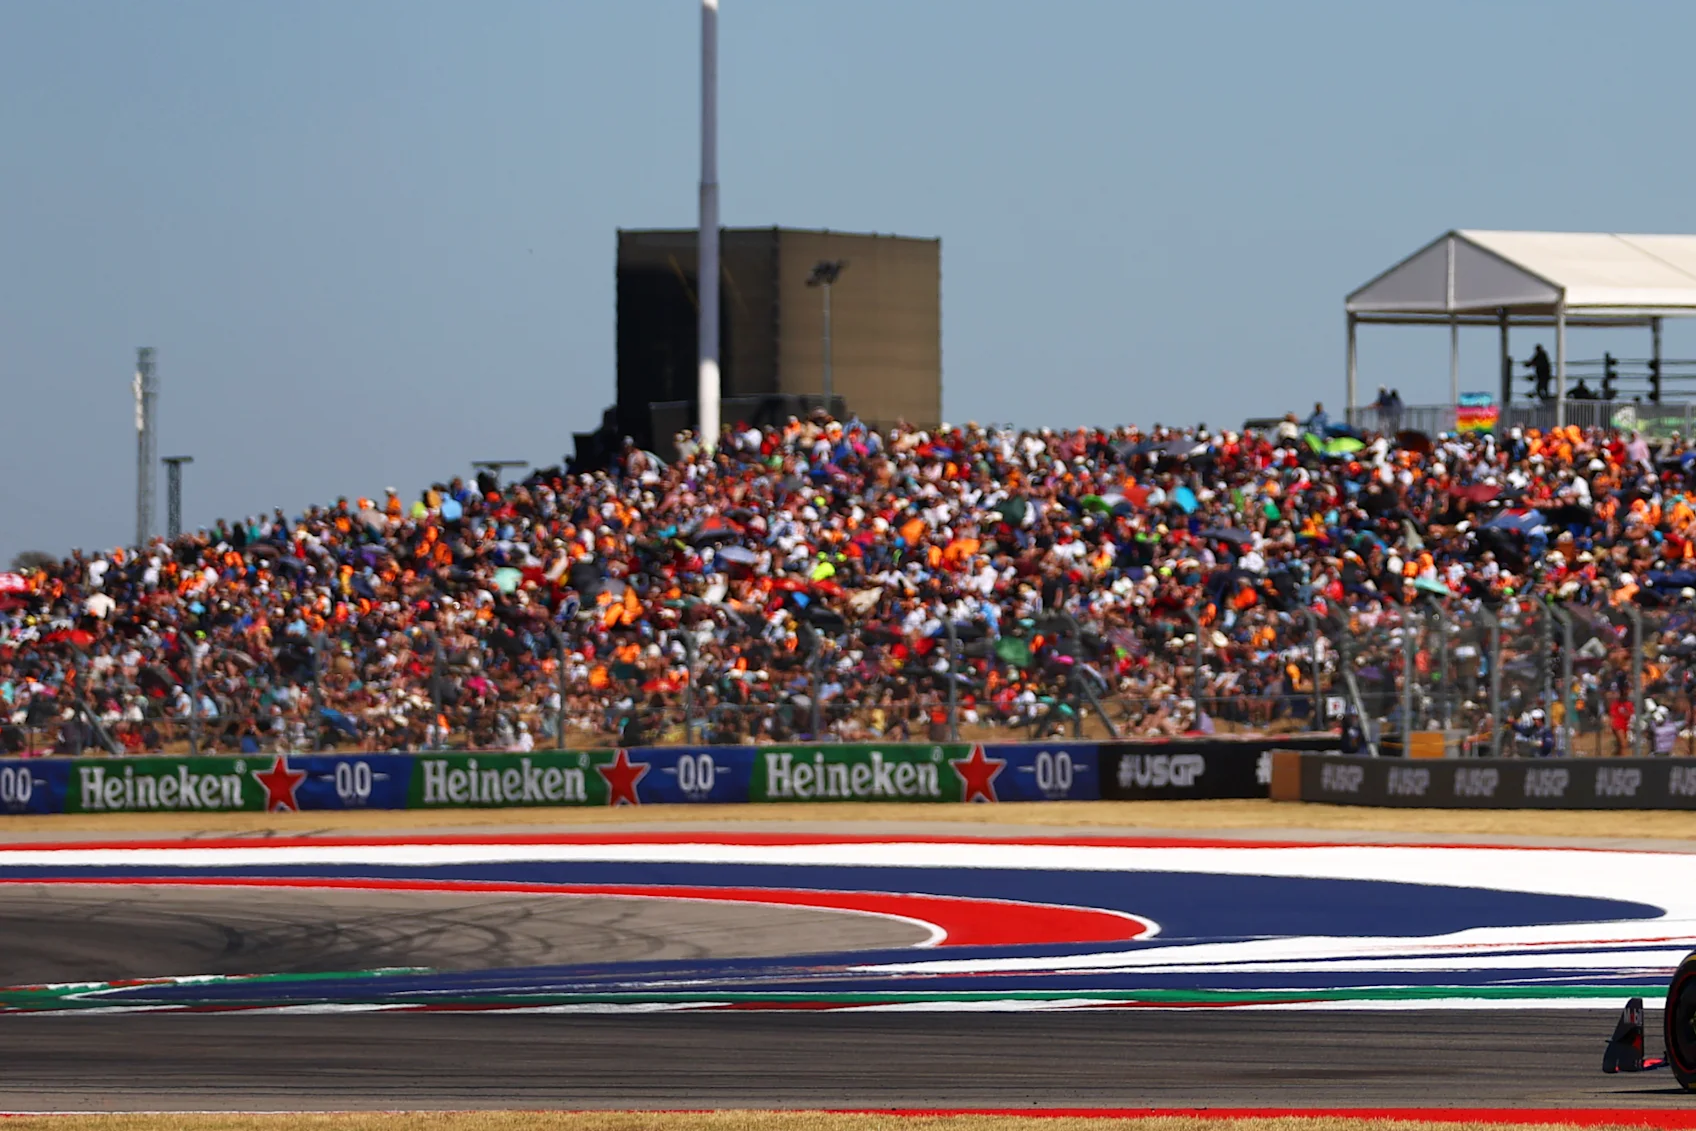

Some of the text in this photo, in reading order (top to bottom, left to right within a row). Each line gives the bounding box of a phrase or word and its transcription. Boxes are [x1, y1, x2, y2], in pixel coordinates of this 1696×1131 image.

[78, 765, 245, 810] Heineken
[422, 758, 588, 804] Heineken
[764, 750, 942, 799] Heineken
[1117, 752, 1206, 789] #USGP
